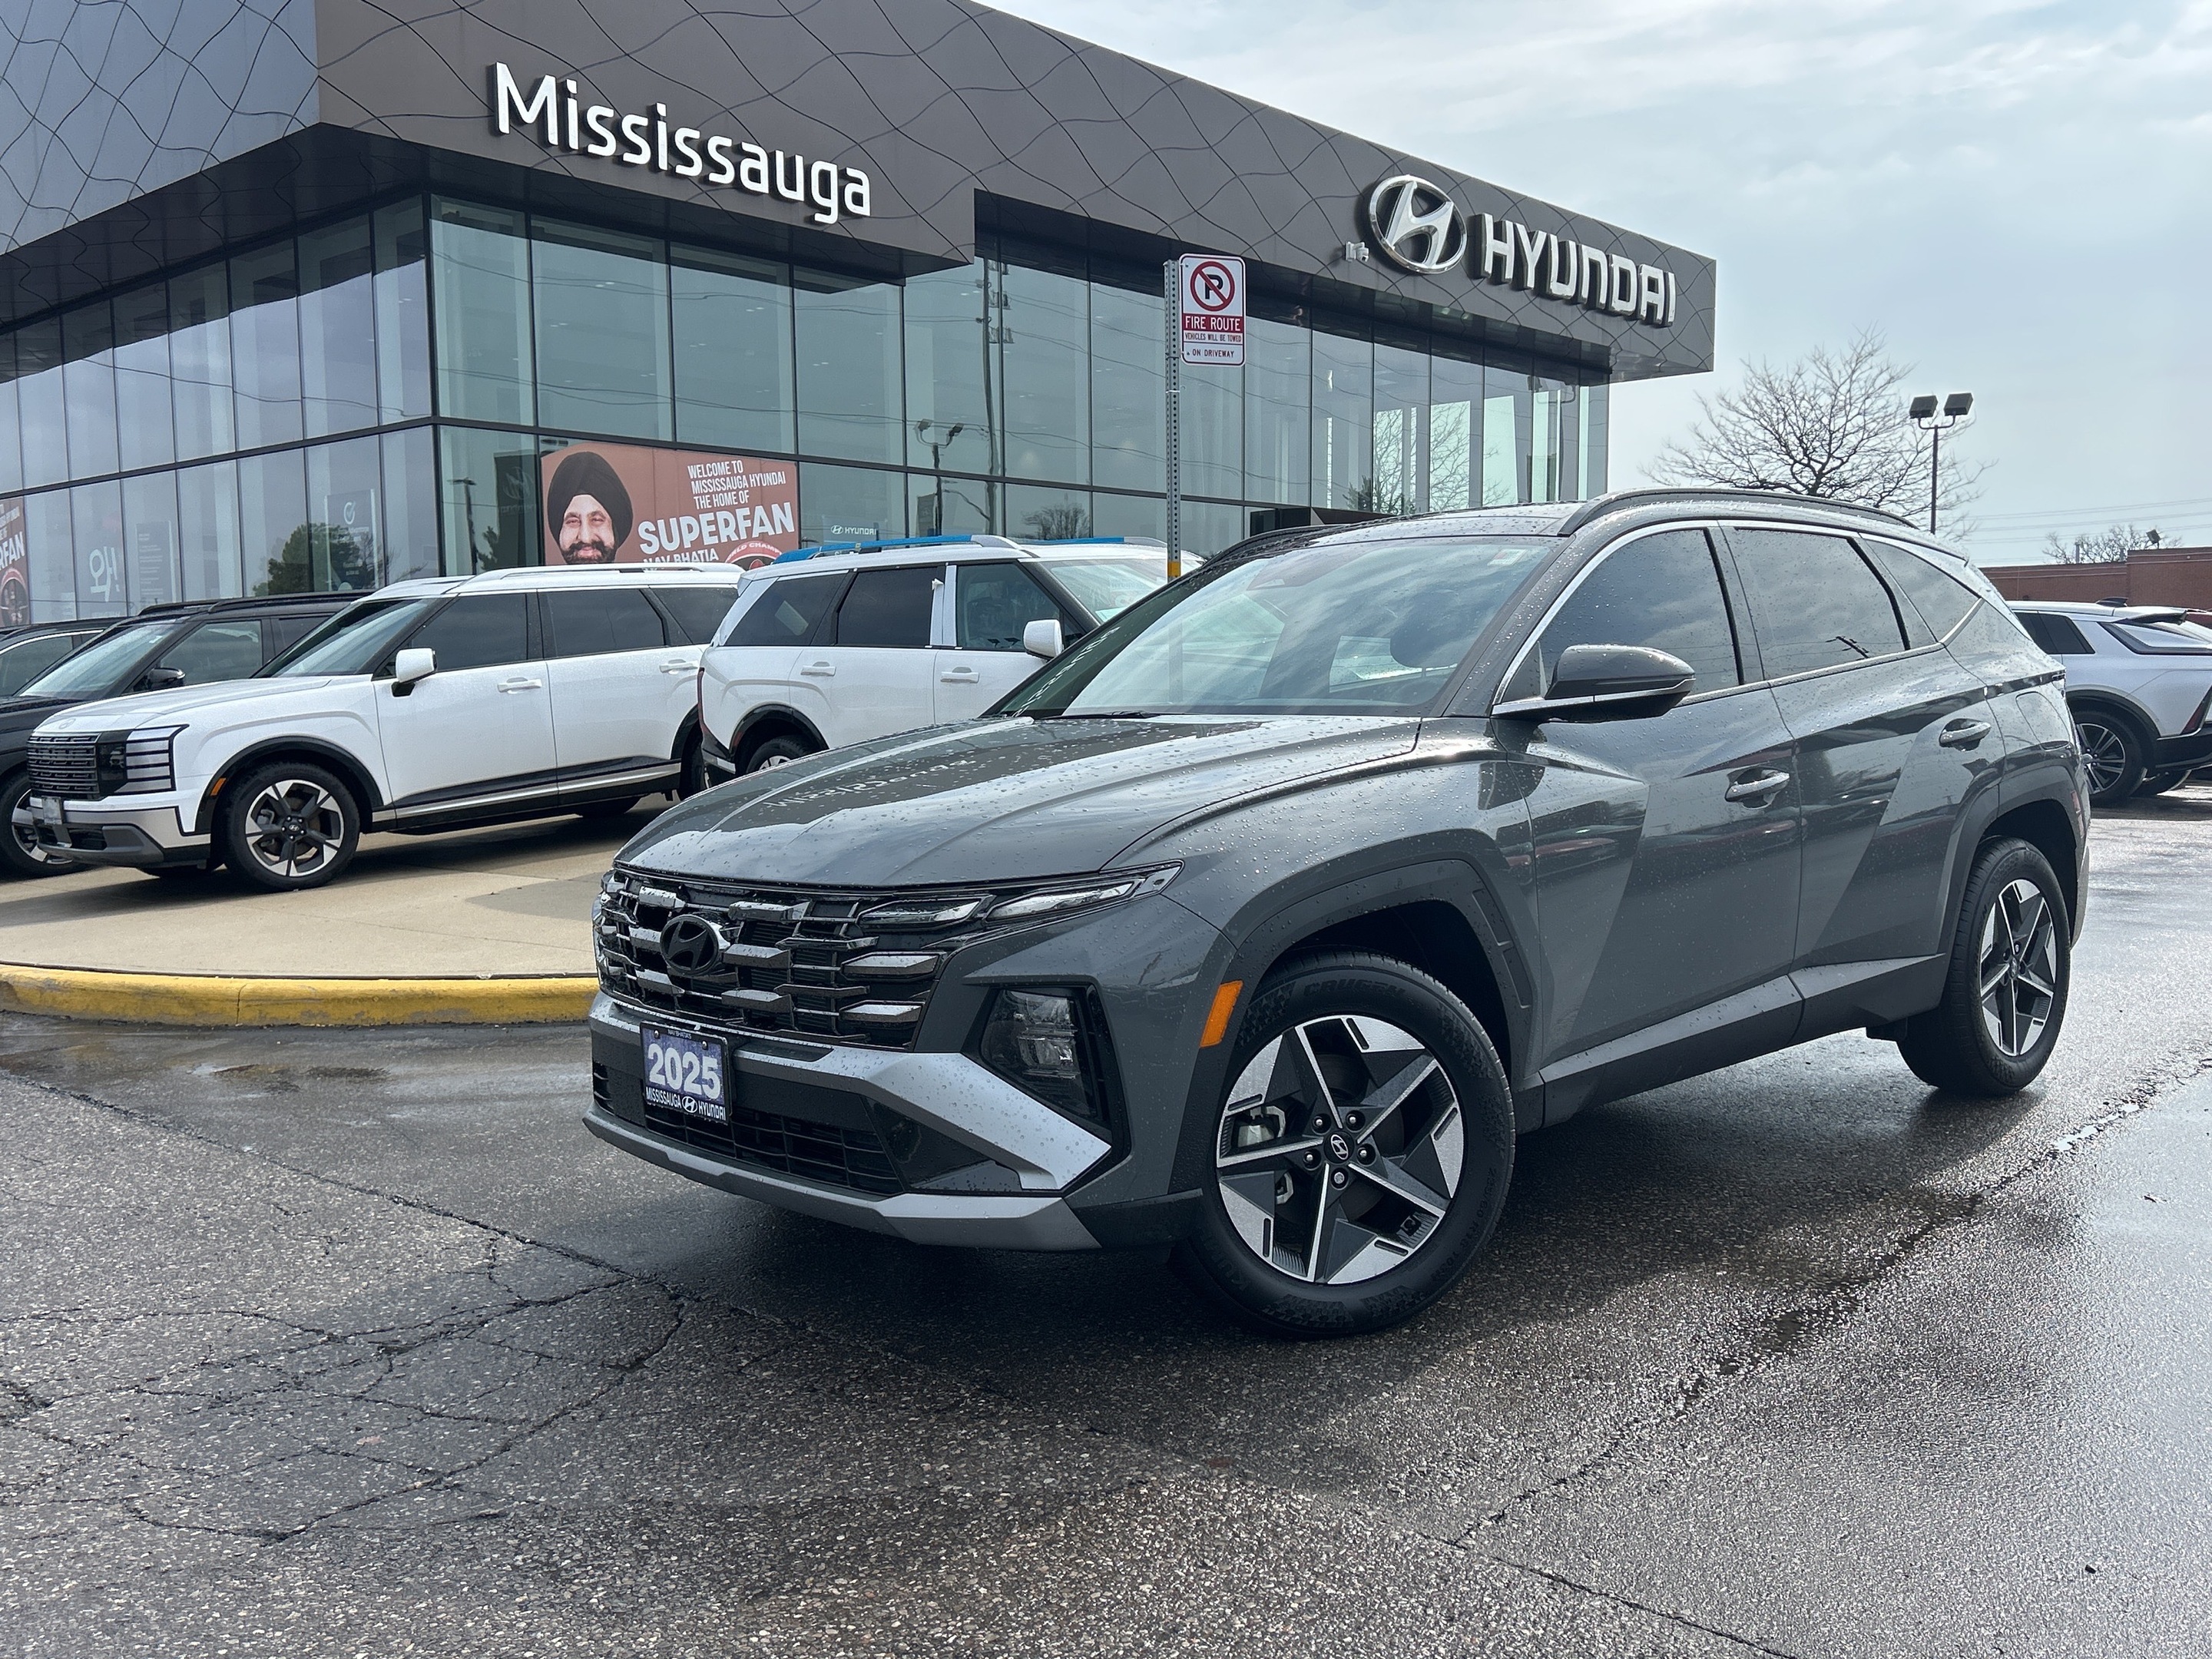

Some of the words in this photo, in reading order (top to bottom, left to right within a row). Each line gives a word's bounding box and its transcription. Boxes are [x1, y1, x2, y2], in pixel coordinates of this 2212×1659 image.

[495, 61, 871, 224] Mississauga
[1482, 212, 1677, 326] HYUNDAI
[1185, 316, 1207, 329] FIRE
[1210, 317, 1240, 331] ROUTE
[1204, 349, 1234, 358] DRIVEWAY
[687, 461, 731, 478] WELCOME
[731, 460, 743, 473] TO
[690, 475, 749, 494] MISSISSAUGA
[749, 471, 786, 488] HYUNDAI
[694, 495, 712, 510] THE
[713, 492, 738, 507] HOME
[739, 490, 750, 504] OF
[637, 502, 795, 555] SUPERFAN
[844, 527, 876, 535] HYUNDAI
[647, 1043, 721, 1099] 2025
[645, 1086, 682, 1109] MISSISSAUGA
[697, 1100, 727, 1121] HYUNDAI
